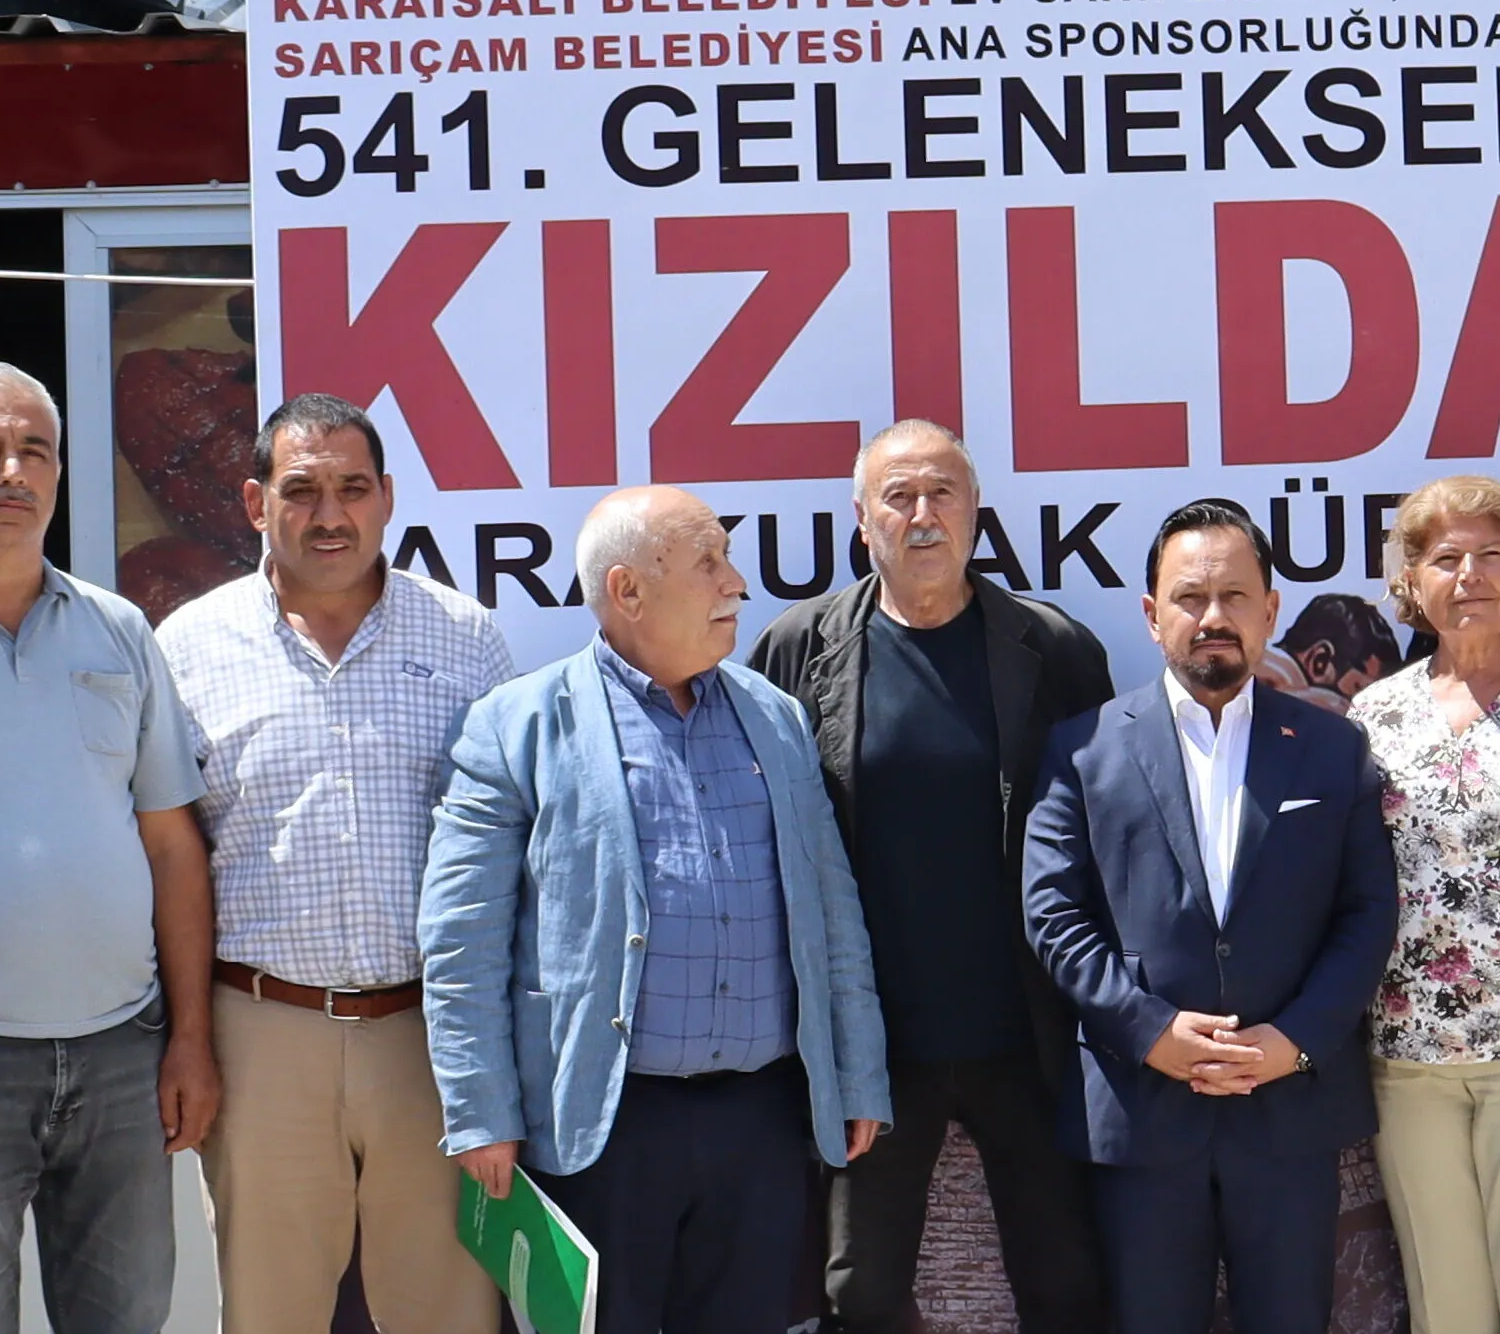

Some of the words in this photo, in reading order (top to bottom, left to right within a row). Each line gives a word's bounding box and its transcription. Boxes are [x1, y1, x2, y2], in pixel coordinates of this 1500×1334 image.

[274, 38, 527, 84] SARIÇAM
[554, 20, 883, 71] BELEDİYESİ
[902, 25, 1006, 61] ANA
[275, 90, 546, 198] 541.
